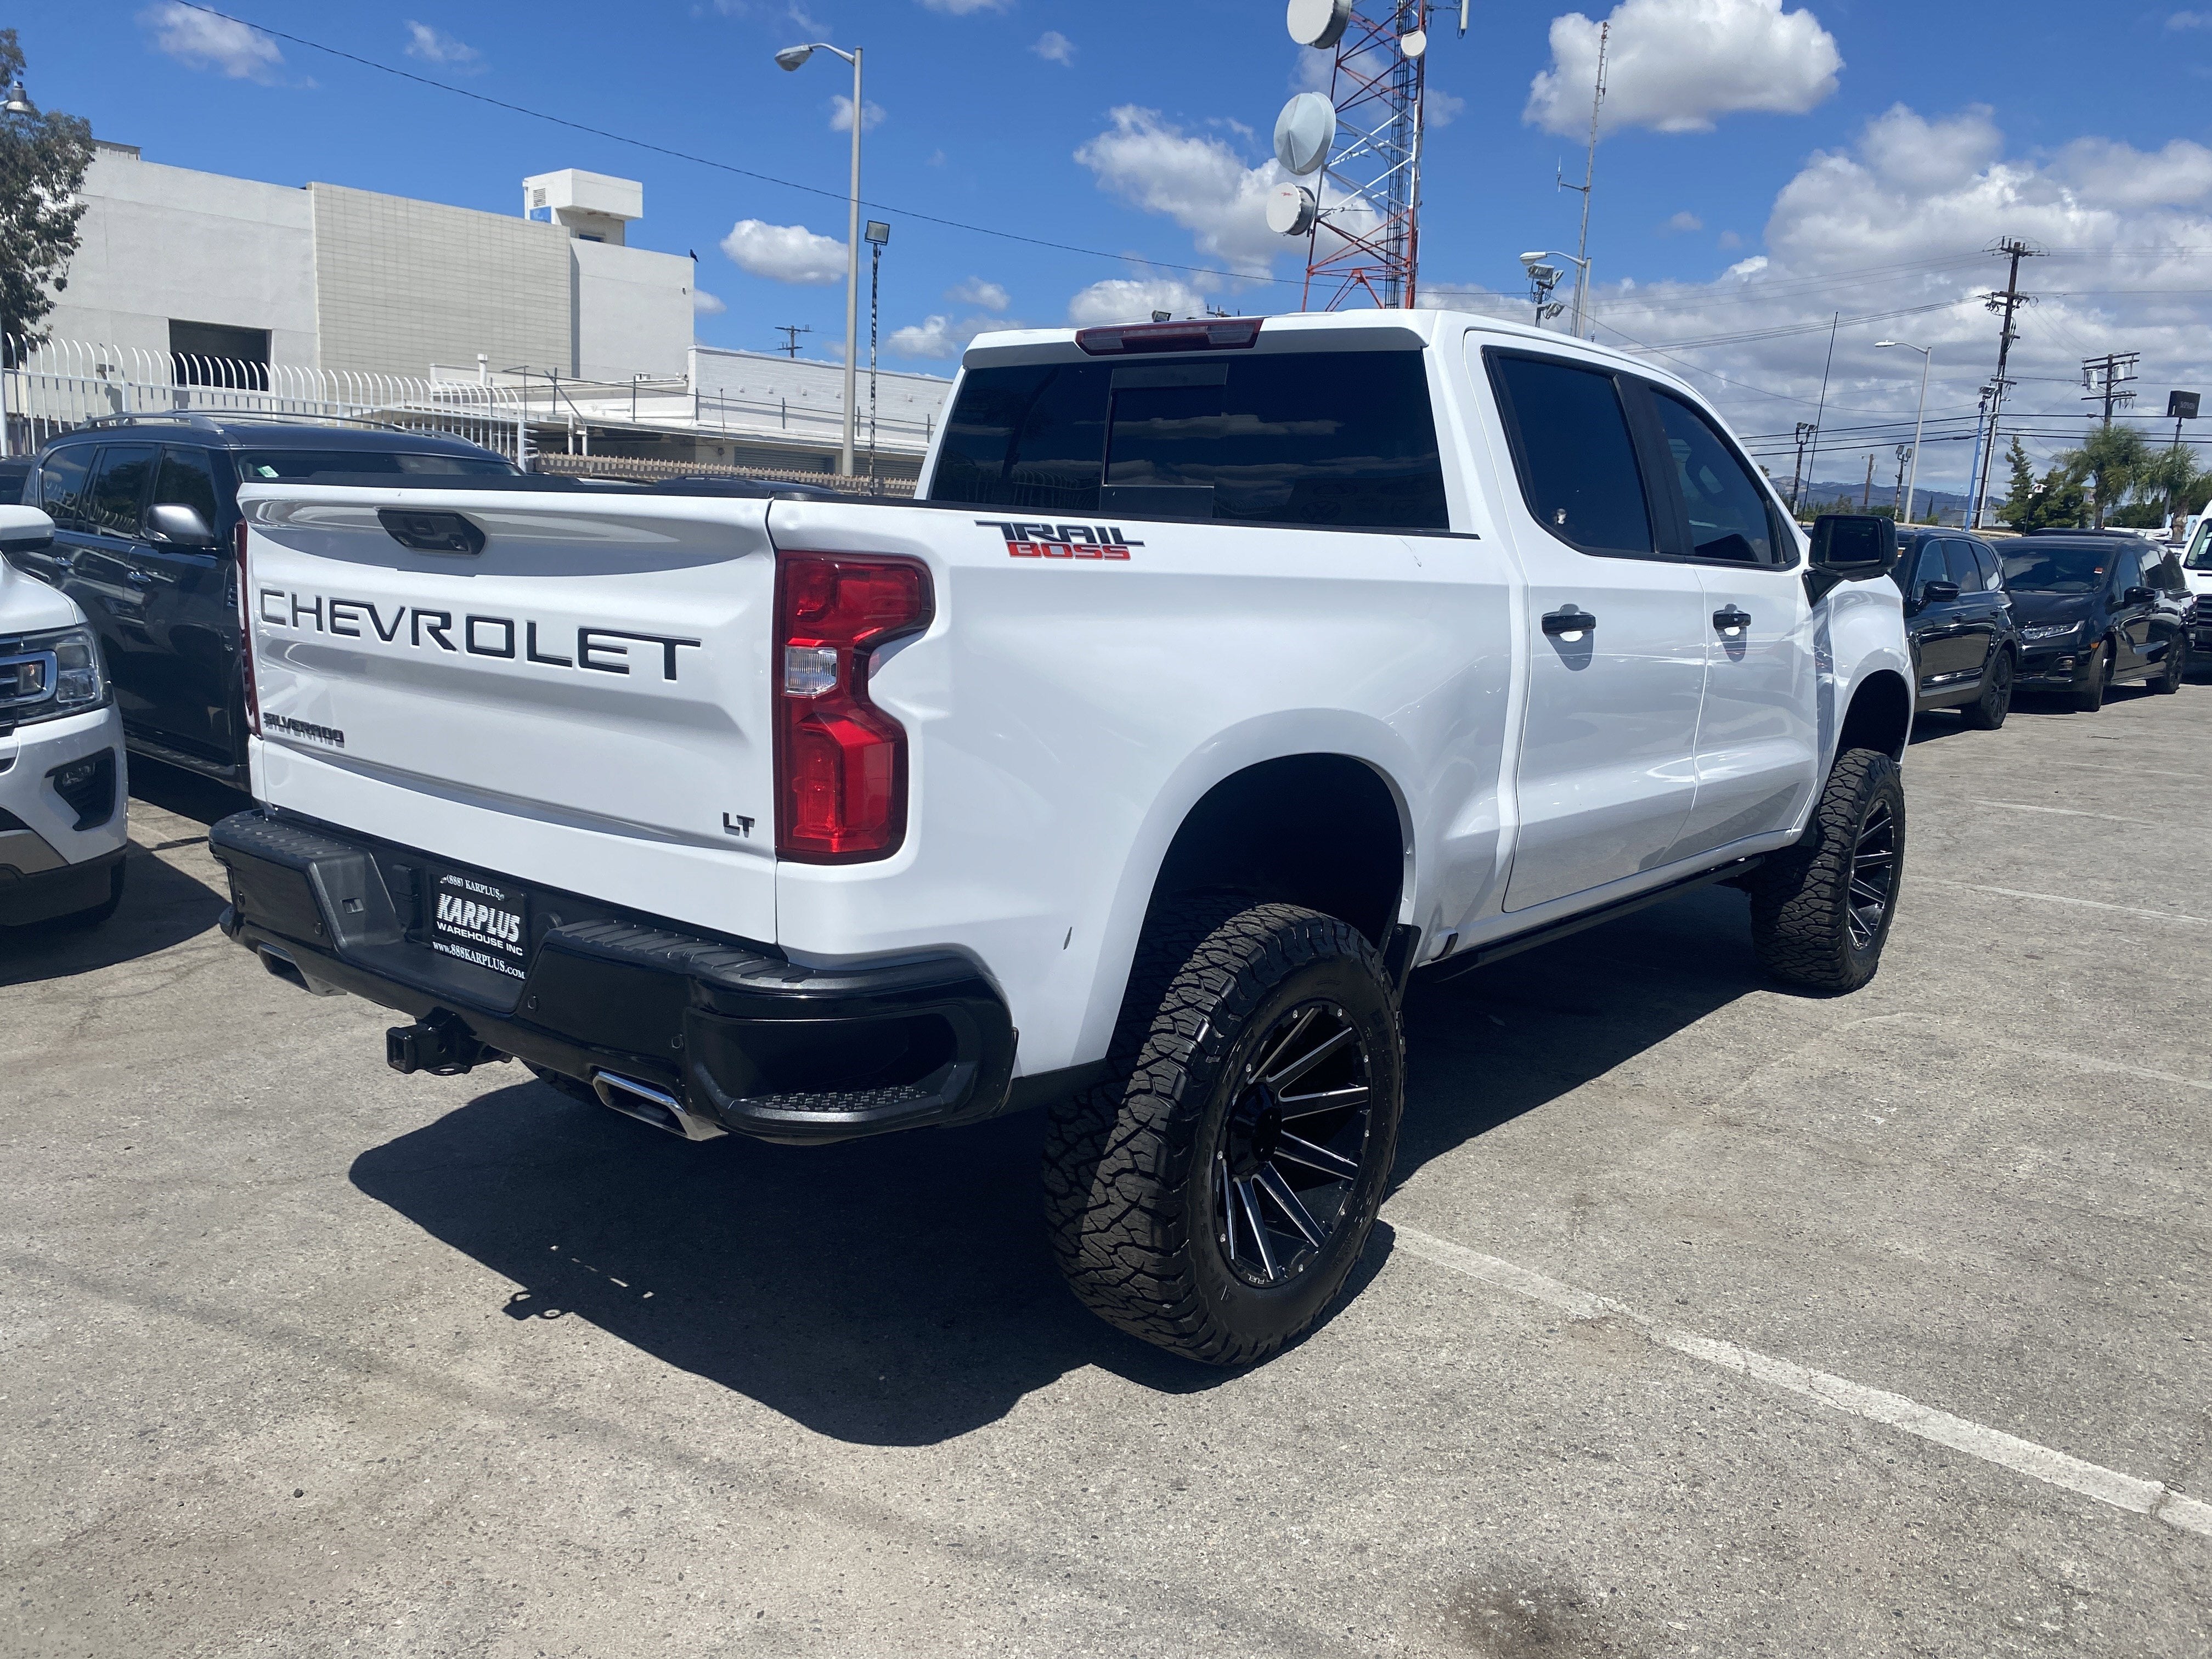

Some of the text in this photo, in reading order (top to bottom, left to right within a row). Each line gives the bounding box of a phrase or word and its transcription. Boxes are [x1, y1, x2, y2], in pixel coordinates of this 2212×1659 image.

[974, 520, 1146, 547] TRAIL
[1006, 541, 1131, 561] BOSS
[259, 588, 702, 681] CHEVROLET
[263, 712, 345, 743] SILVERADO
[723, 811, 755, 832] LT
[447, 874, 500, 899] (888) KARPLUS
[436, 893, 521, 943] KARPLUS
[436, 921, 523, 956] WAREHOUSE INC
